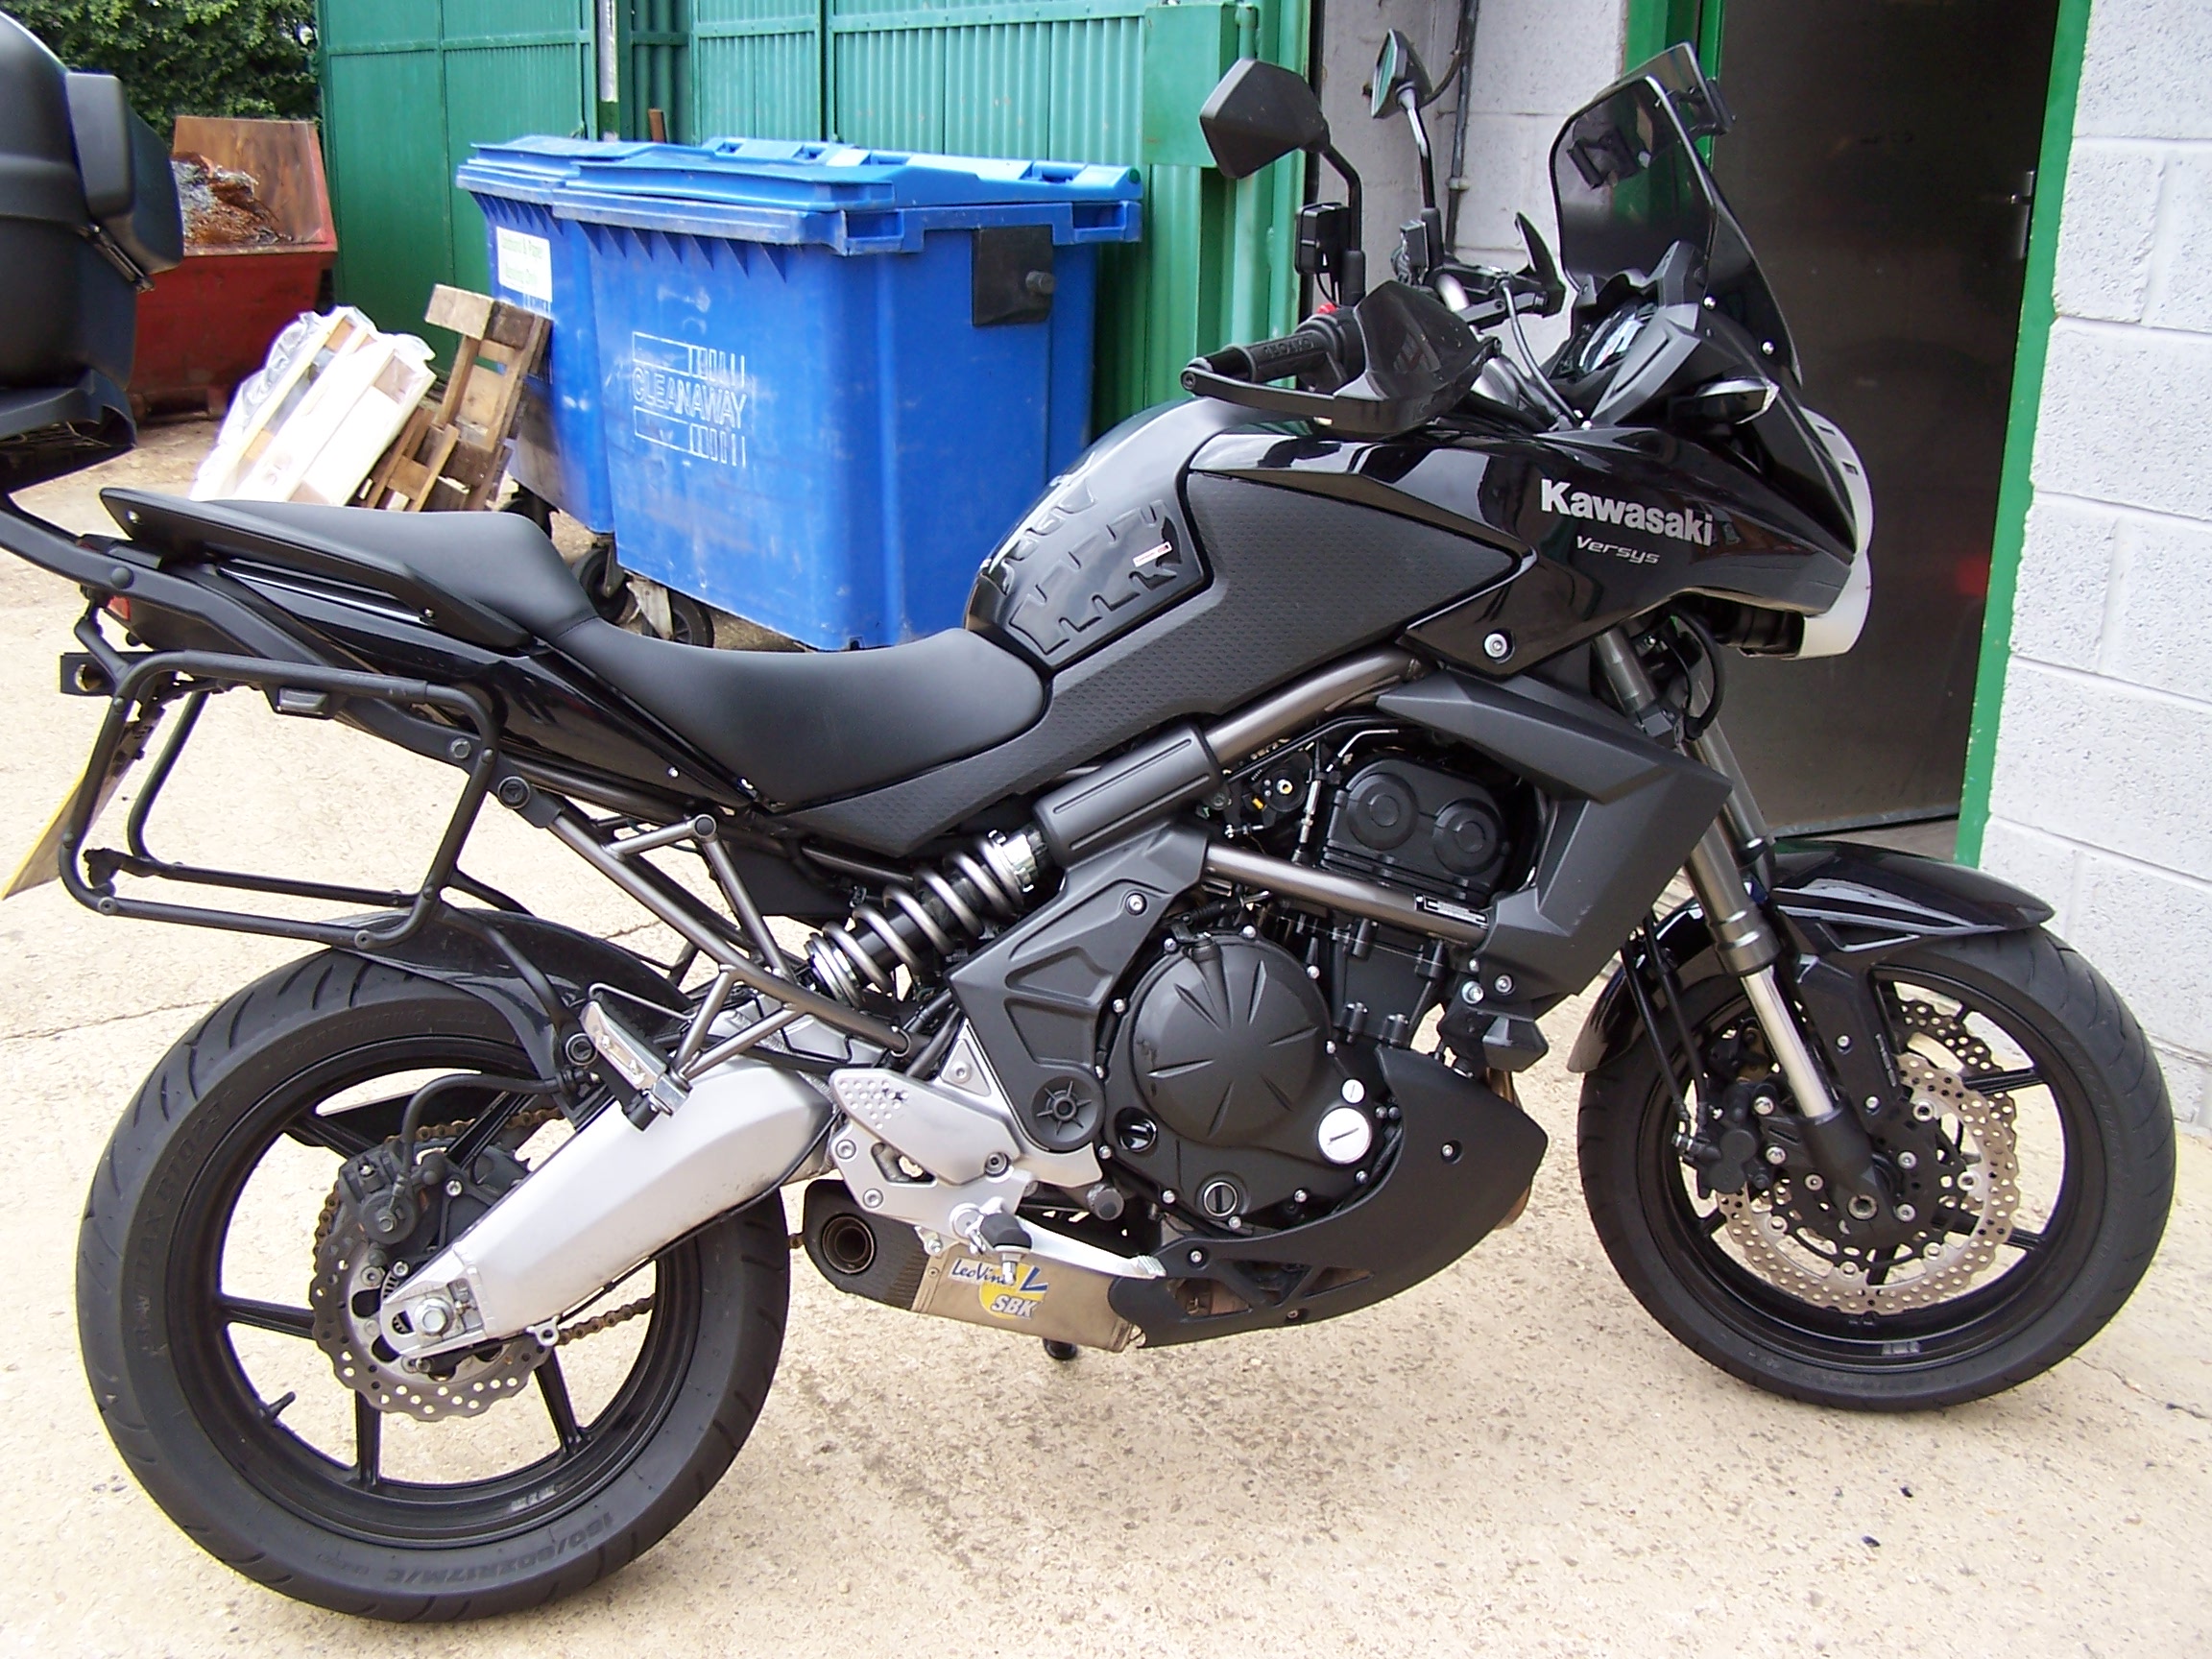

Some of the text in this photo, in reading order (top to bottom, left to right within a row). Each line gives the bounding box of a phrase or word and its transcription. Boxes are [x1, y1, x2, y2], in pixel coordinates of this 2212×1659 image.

[631, 366, 748, 429] CLEANAWAY
[1540, 478, 1714, 547] Kawasaki
[1575, 535, 1661, 565] Versys
[991, 1293, 1038, 1319] SBK
